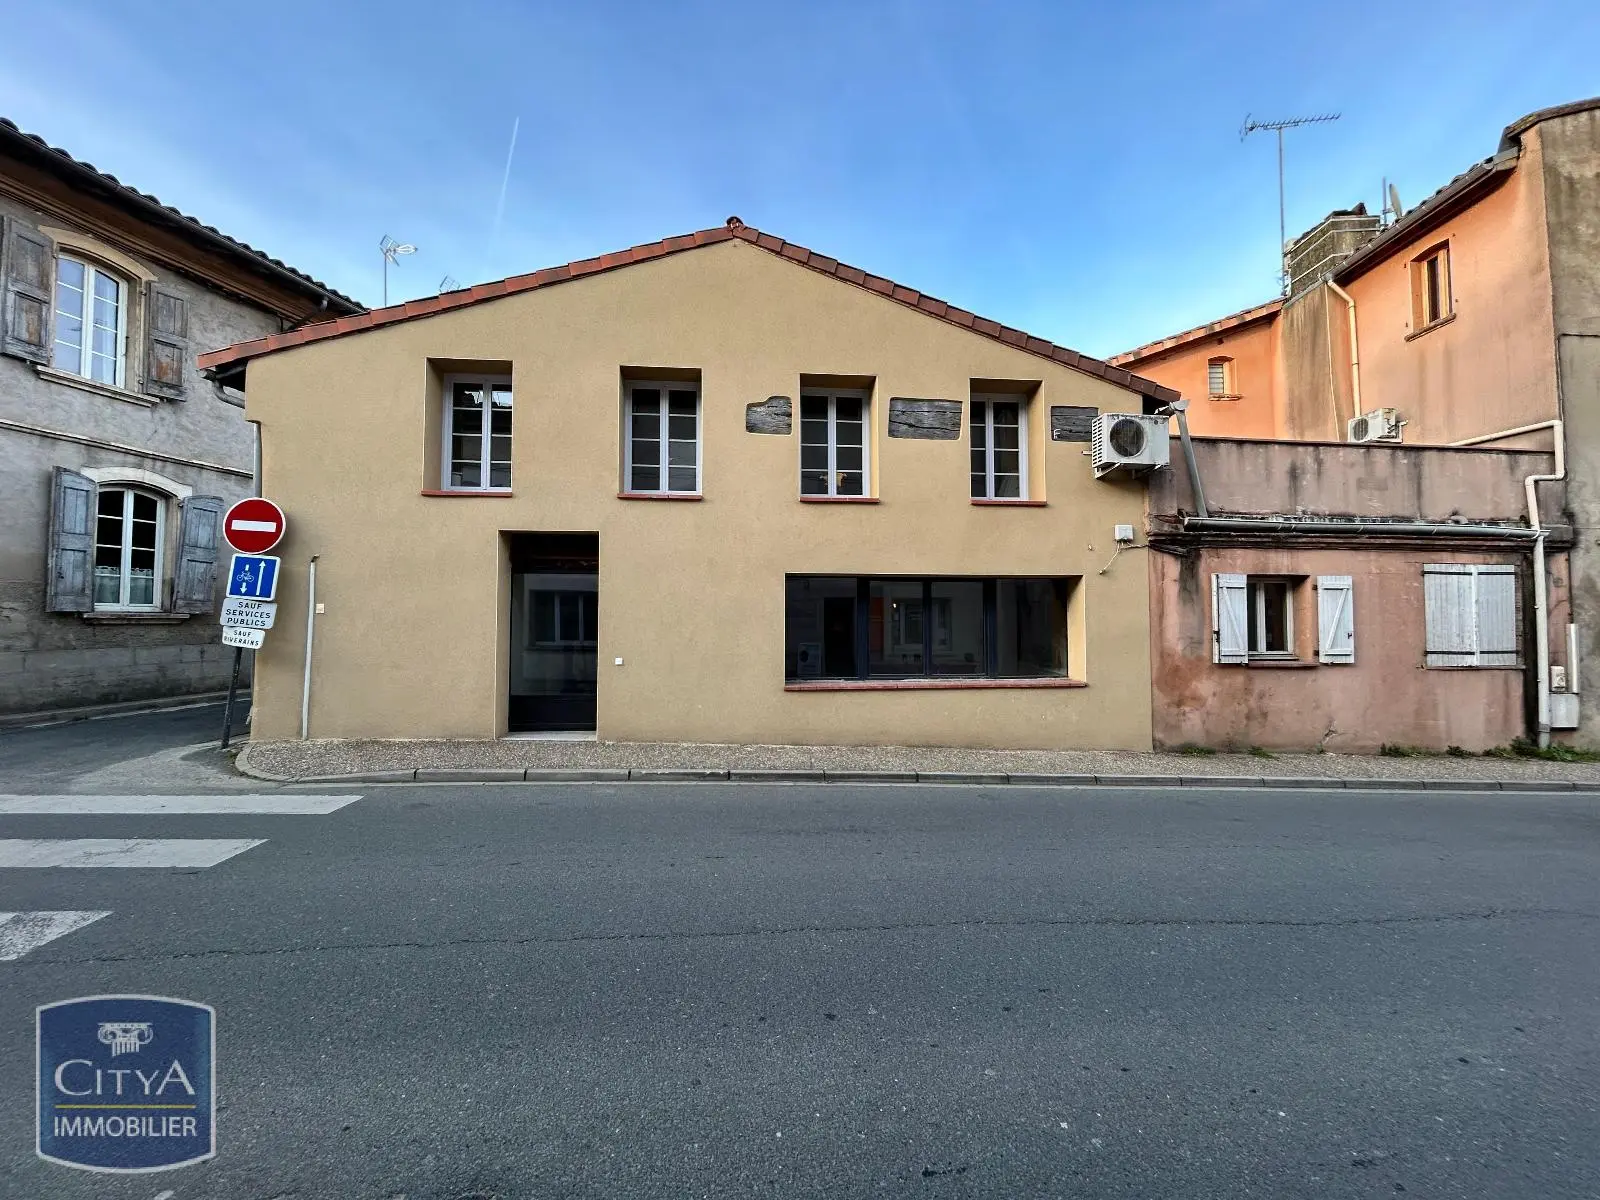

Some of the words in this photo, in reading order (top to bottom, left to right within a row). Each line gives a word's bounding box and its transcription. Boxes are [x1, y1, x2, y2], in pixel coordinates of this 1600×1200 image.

[238, 601, 263, 610] SAUF
[225, 608, 271, 619] SERVICES
[227, 617, 266, 627] PUBLICS
[233, 630, 252, 638] SAUF
[224, 636, 259, 646] RIVERAINS
